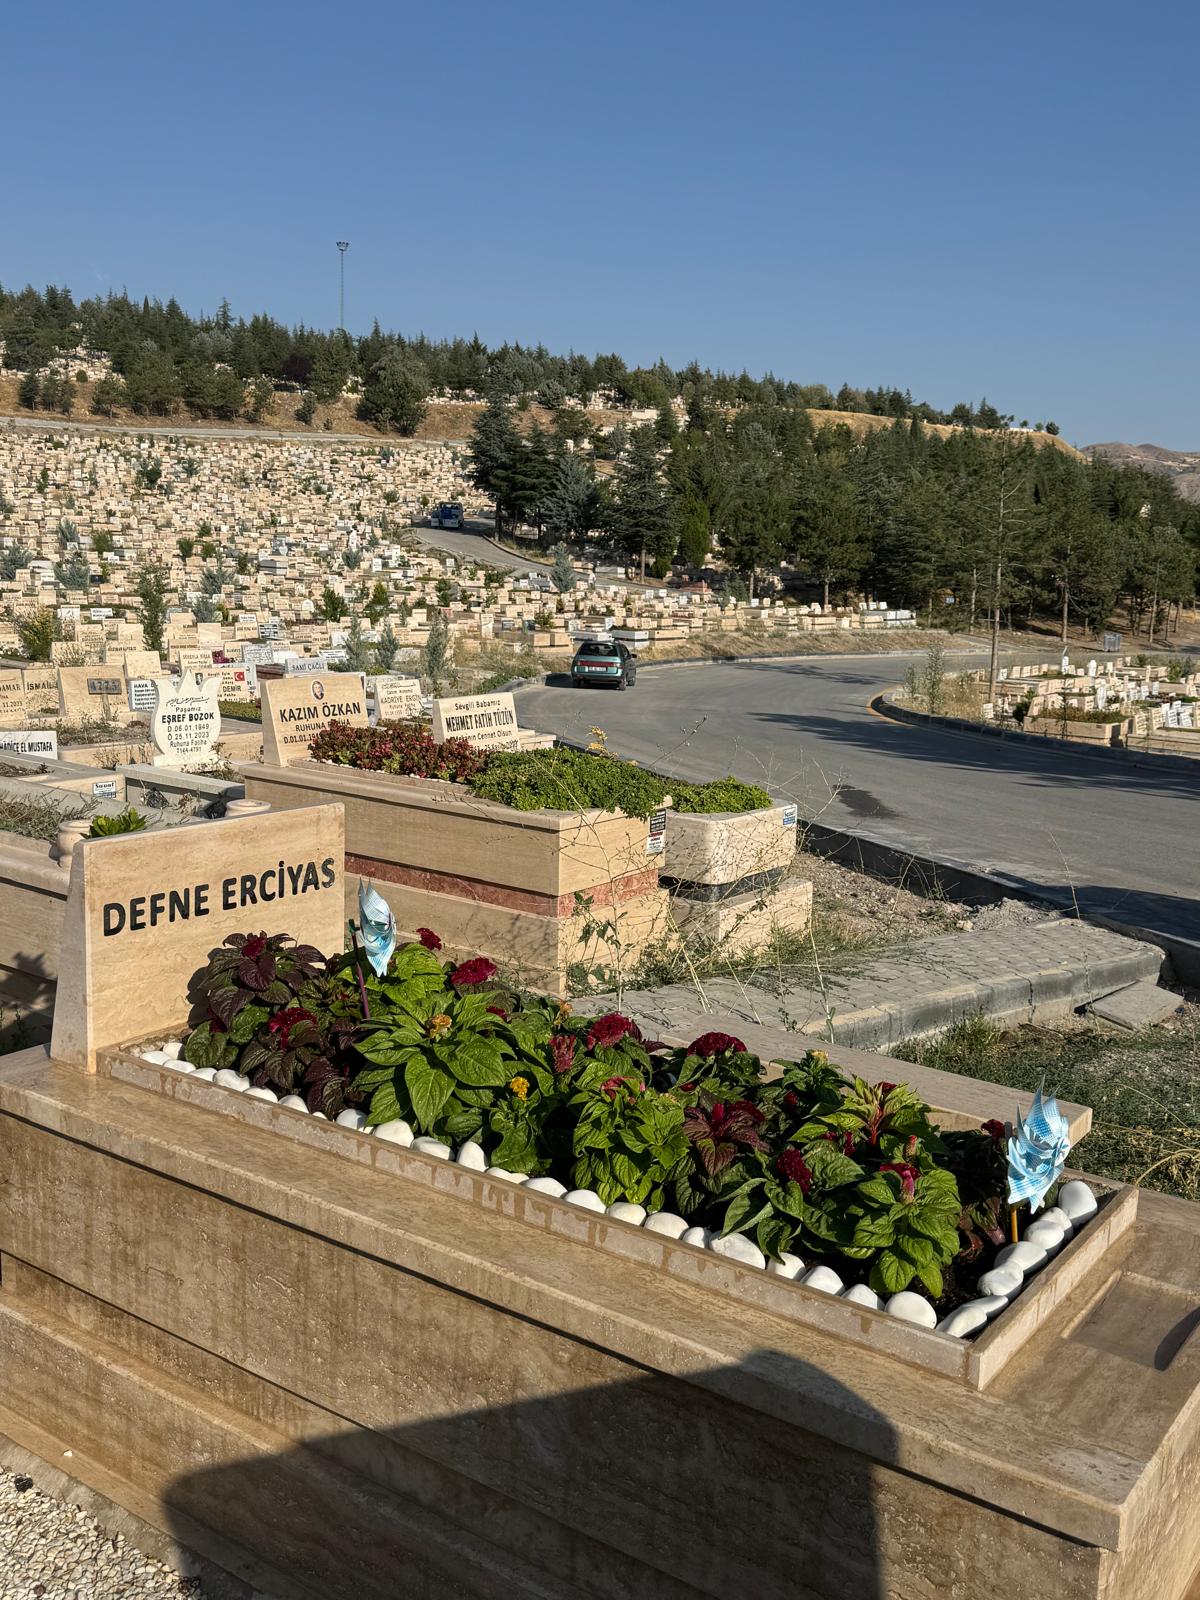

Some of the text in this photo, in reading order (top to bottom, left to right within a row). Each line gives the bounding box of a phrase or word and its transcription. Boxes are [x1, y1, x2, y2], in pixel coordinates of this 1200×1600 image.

[454, 700, 500, 711] Sevgili Babamız
[280, 702, 361, 722] KAZIM ÖZKAN
[161, 712, 214, 725] EŞREF BOZOK
[445, 707, 514, 732] MEHMET FATİH TÜZÜN
[295, 721, 326, 732] RUHUNA
[477, 731, 495, 740] Cennet
[20, 742, 27, 752] EL
[28, 742, 53, 752] MUSTAFA
[103, 857, 335, 937] DEFNE ERCİYAS
